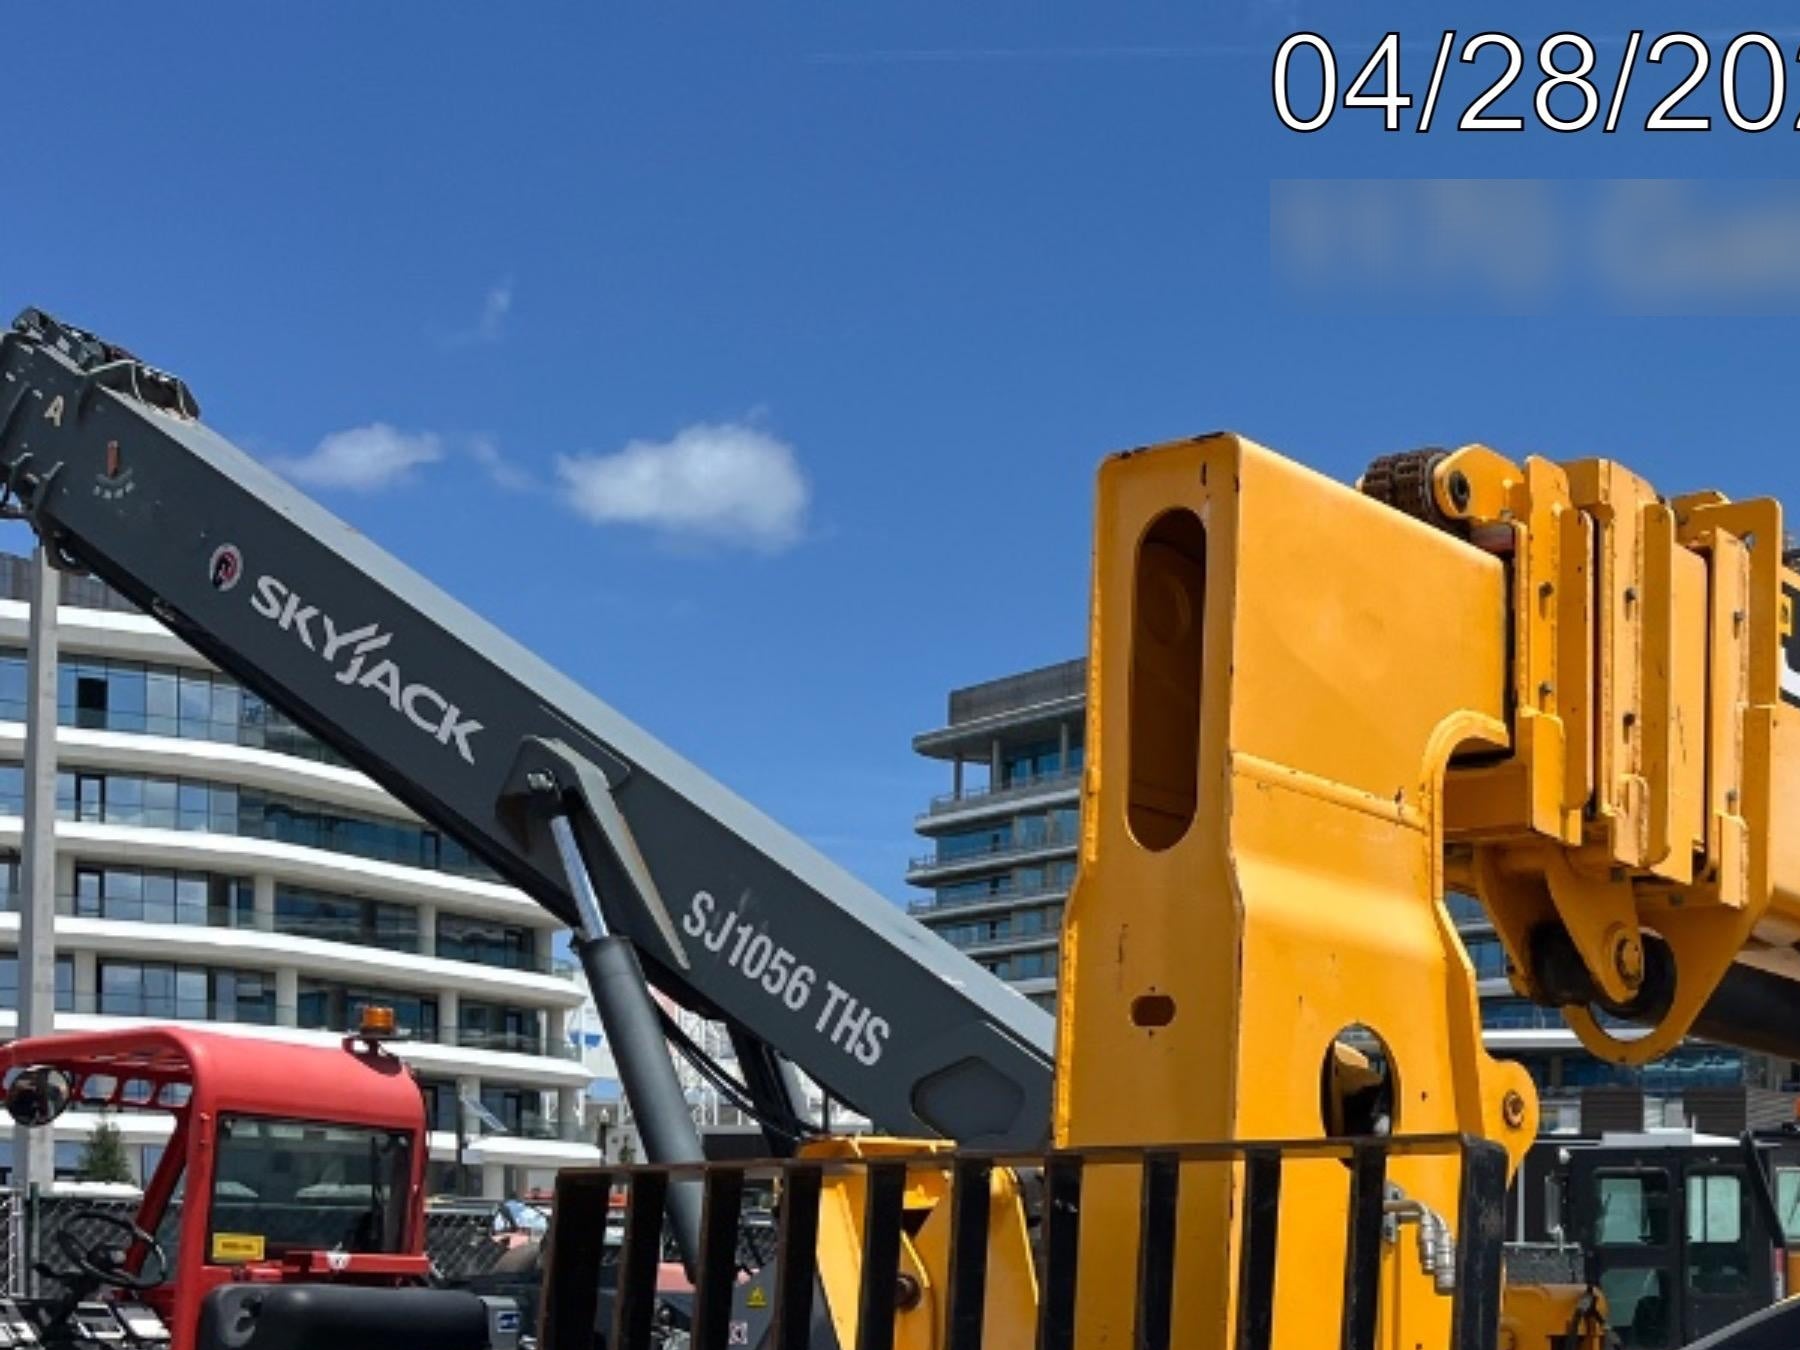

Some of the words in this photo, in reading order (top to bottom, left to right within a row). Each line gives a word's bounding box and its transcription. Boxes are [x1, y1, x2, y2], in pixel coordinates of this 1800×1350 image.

[251, 575, 484, 766] SKYJACK
[683, 890, 816, 1011] SJ1056
[815, 980, 889, 1066] THS
